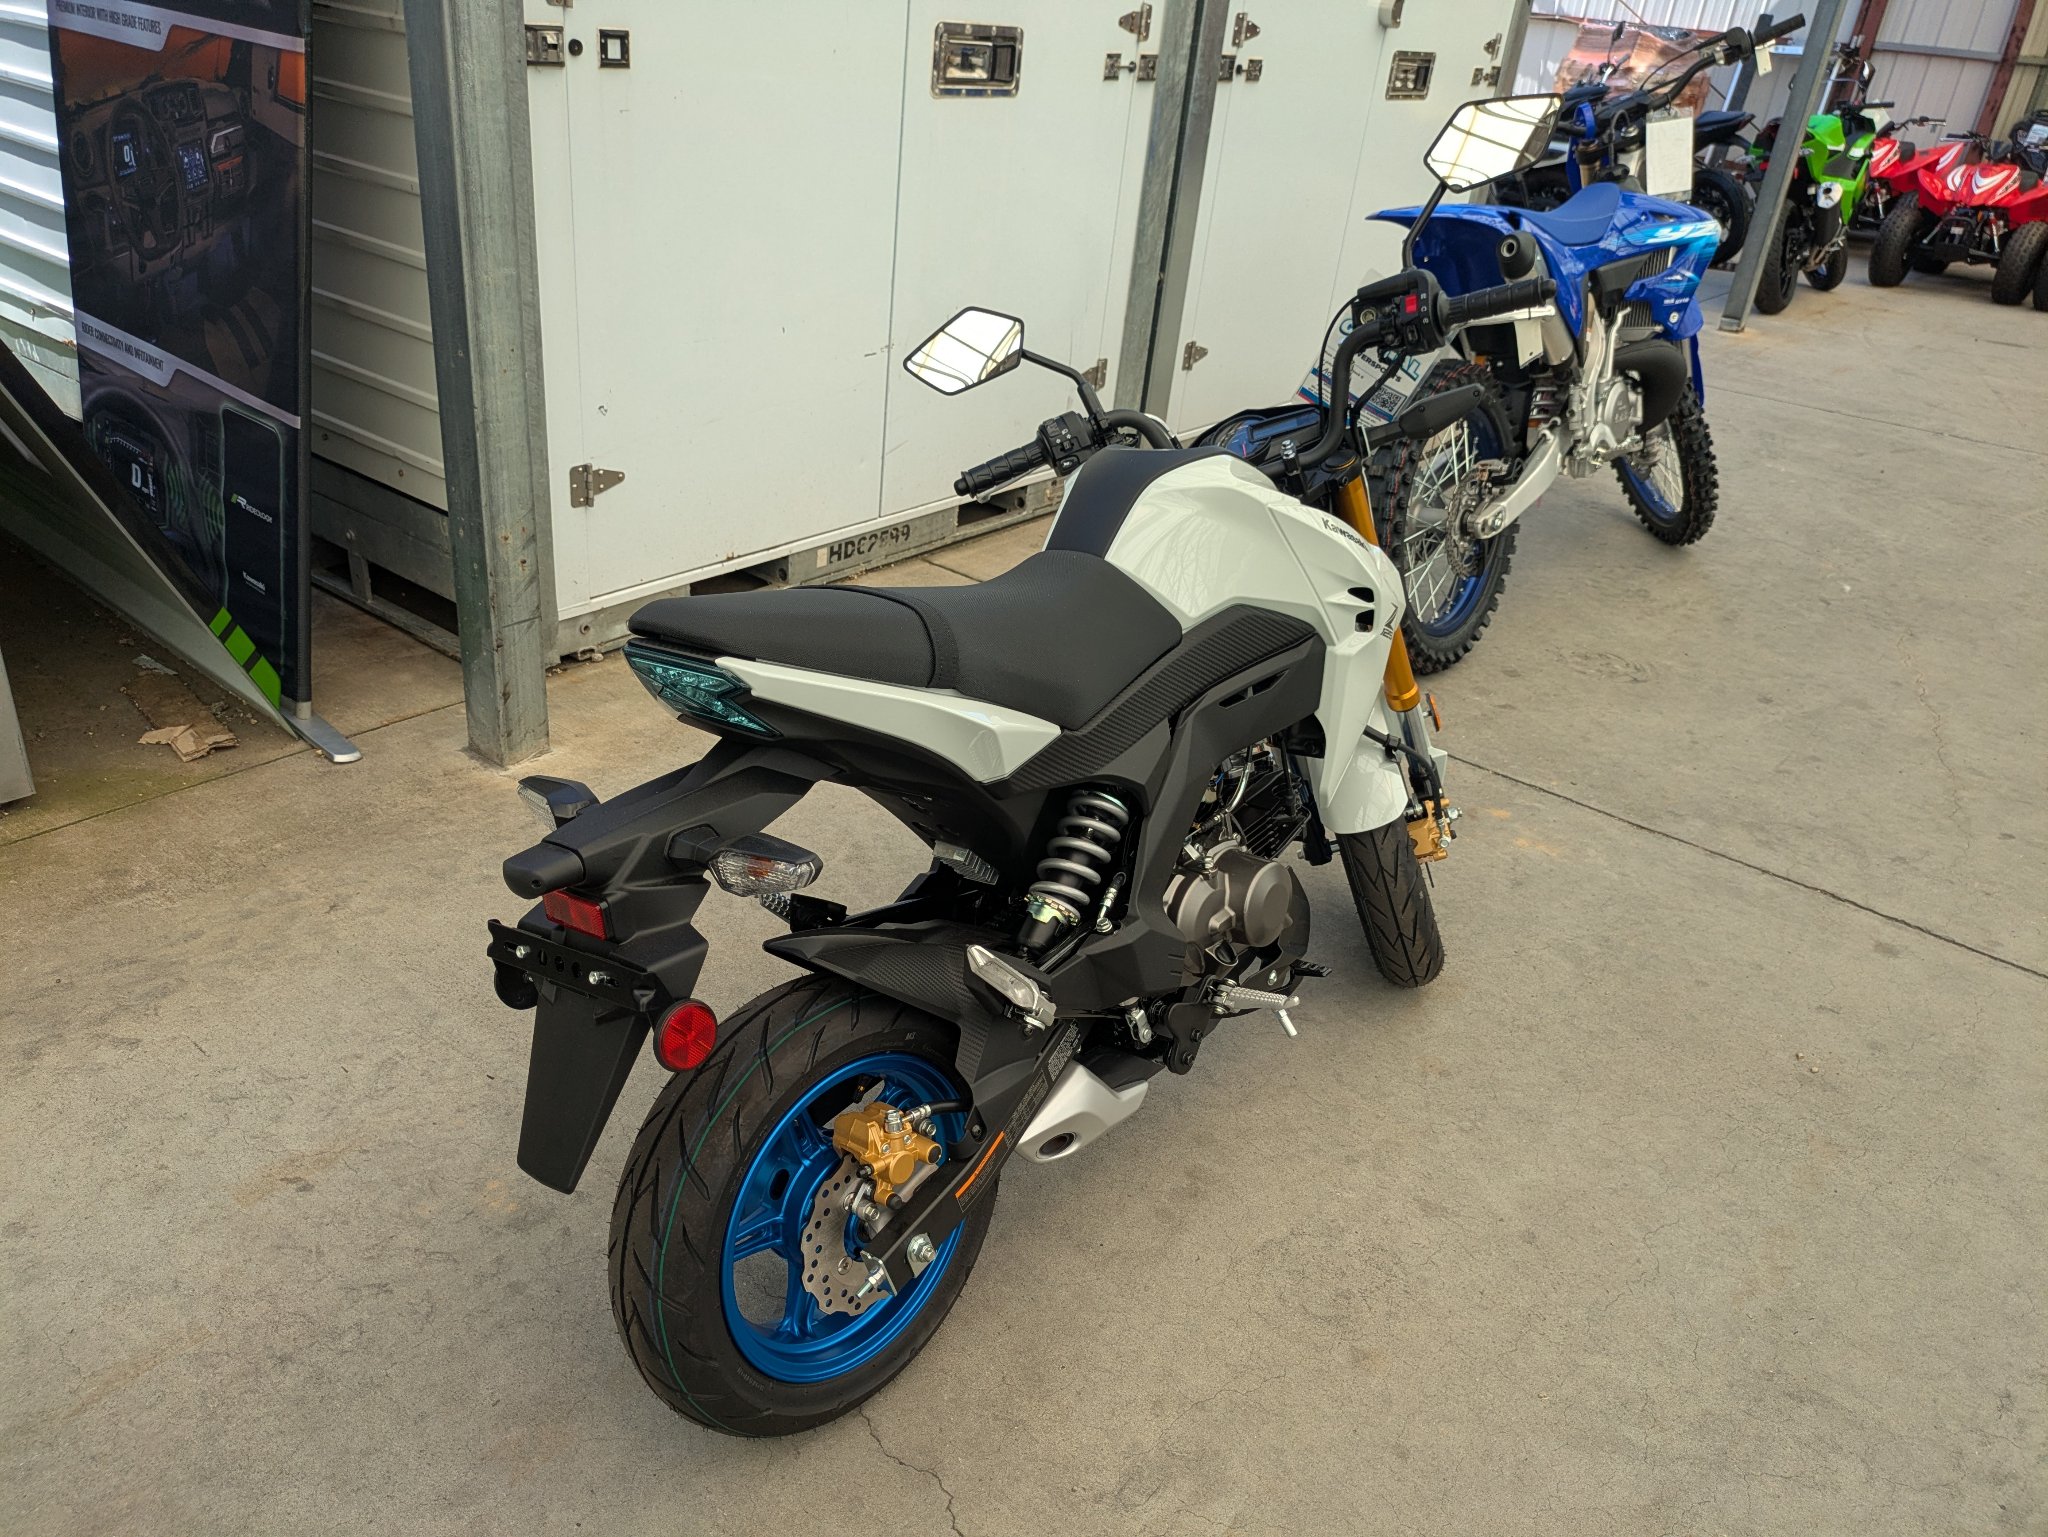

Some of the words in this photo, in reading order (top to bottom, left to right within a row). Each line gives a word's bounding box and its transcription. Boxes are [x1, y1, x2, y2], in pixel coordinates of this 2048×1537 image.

[55, 0, 76, 15] PREMIUM
[76, 3, 96, 19] INTERIOR
[96, 7, 108, 22] WITH
[109, 9, 121, 25] HIGH
[121, 12, 138, 30] GRADE
[138, 16, 162, 35] FEATURES
[81, 321, 94, 337] RIDER
[94, 328, 124, 351] CONNECTIVITY
[124, 342, 134, 356] AND
[134, 347, 164, 372] INFOTAINMENT
[1321, 517, 1370, 552] Kawasaki
